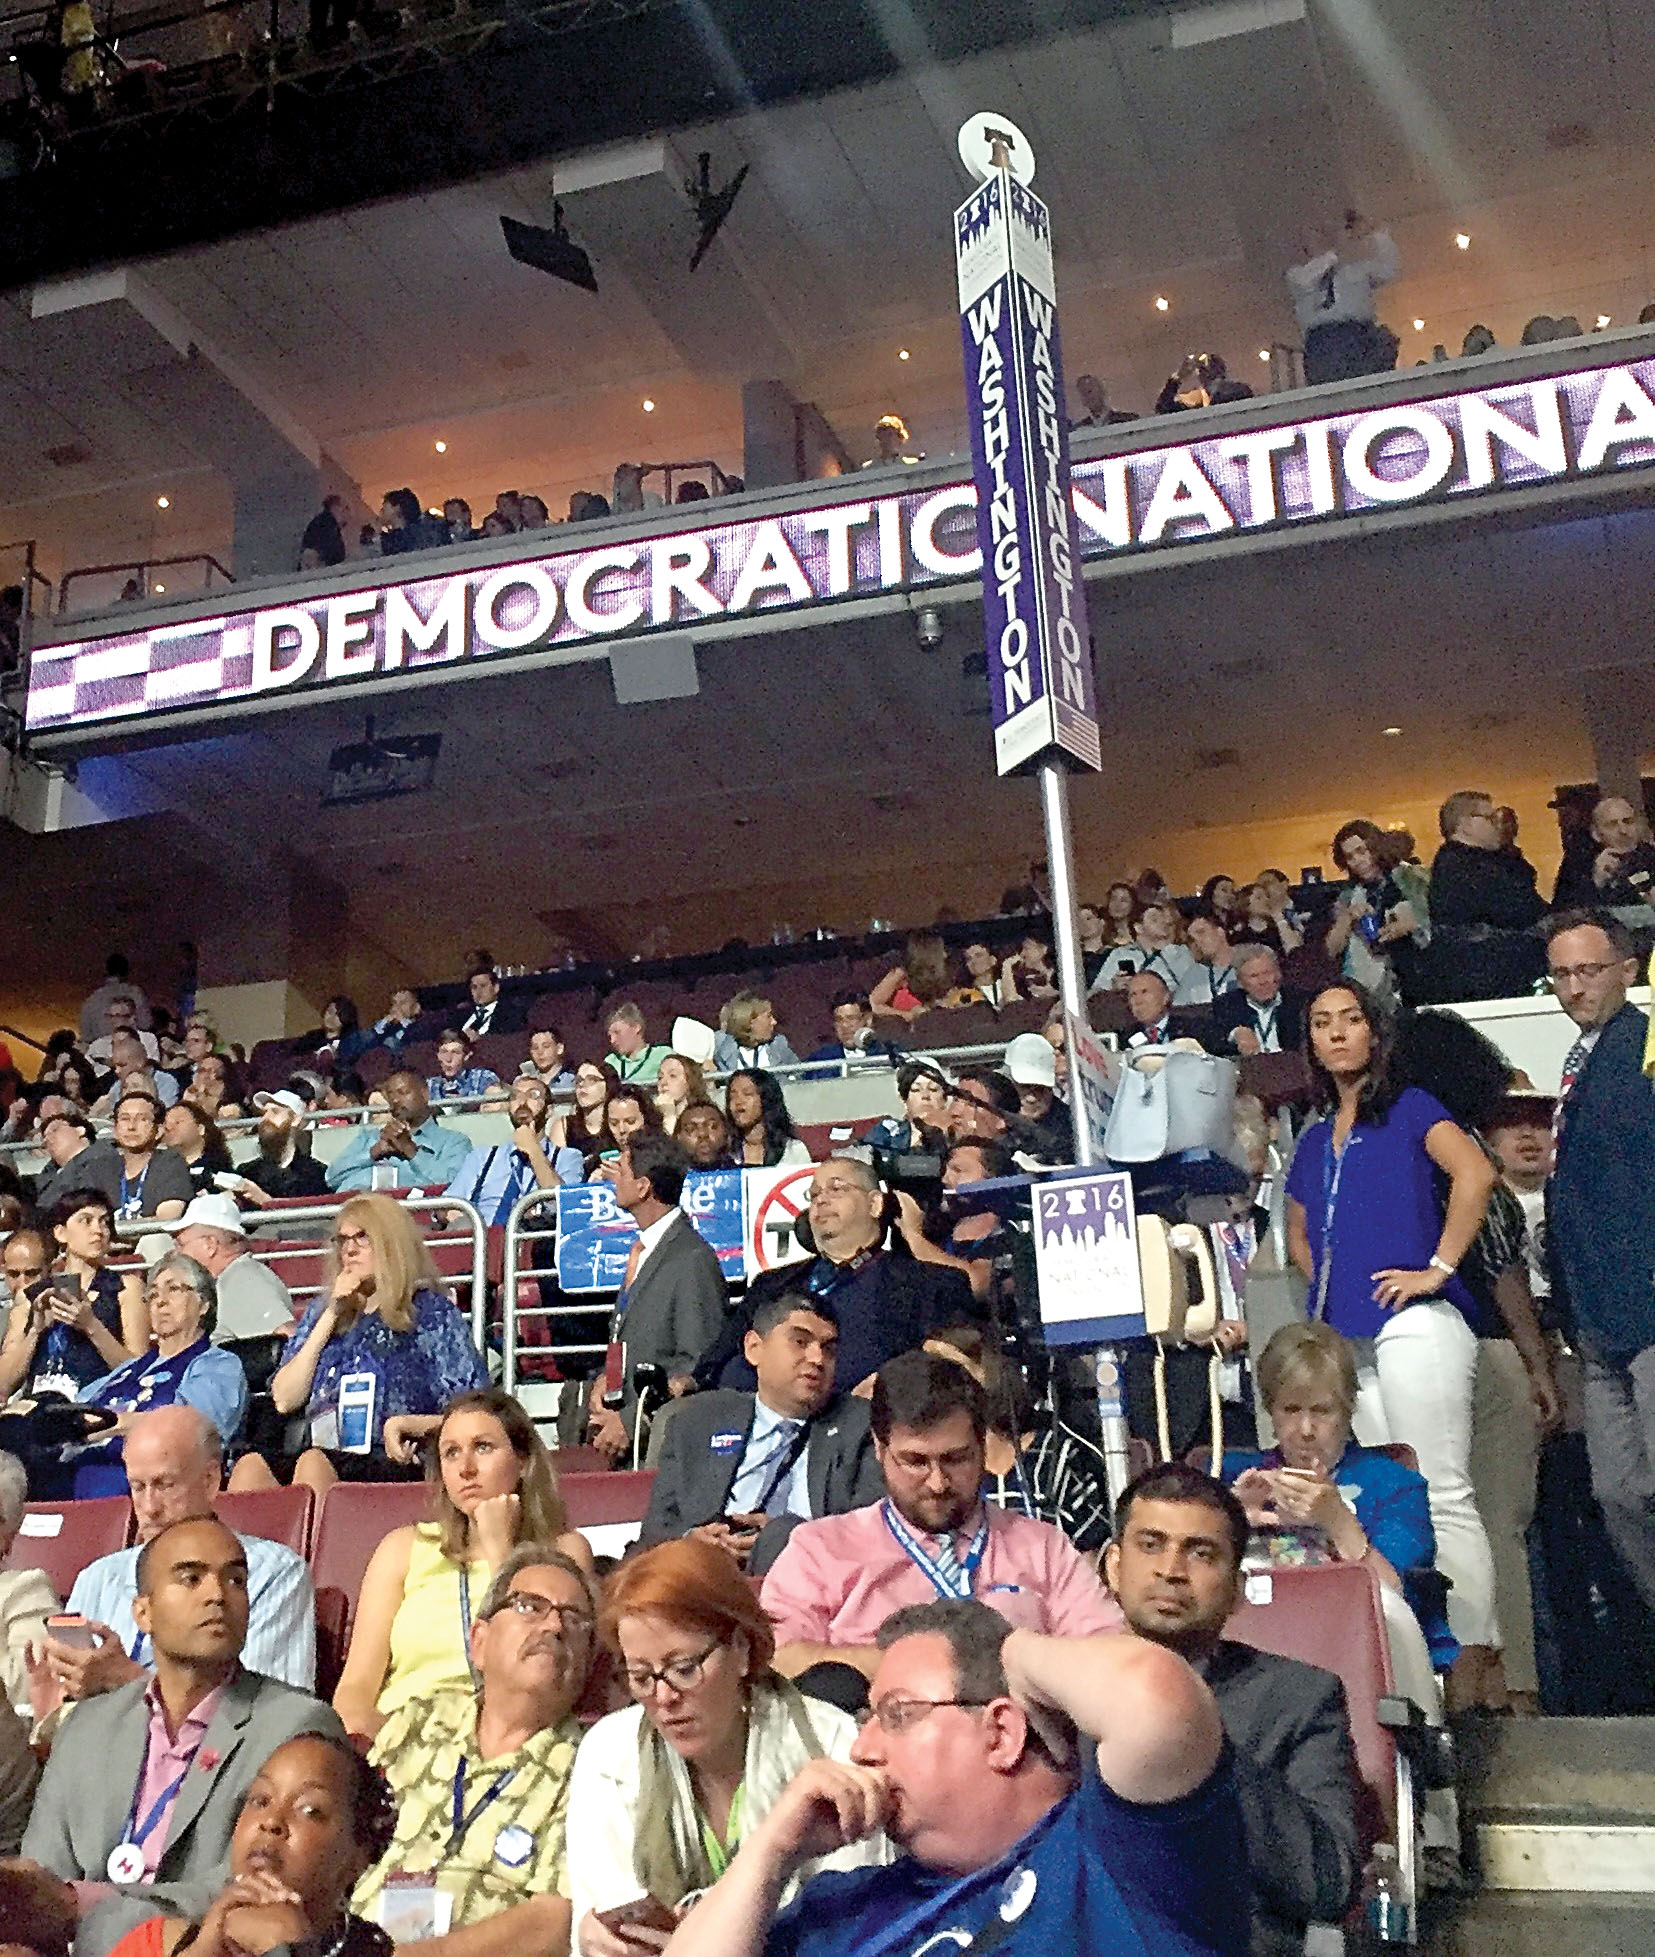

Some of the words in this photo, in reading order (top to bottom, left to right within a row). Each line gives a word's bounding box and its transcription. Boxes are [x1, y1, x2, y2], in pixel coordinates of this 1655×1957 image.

[251, 484, 984, 691] DEMOCRATIC
[968, 283, 1032, 716] WASHINGTON
[1022, 282, 1085, 712] WASHINGTON
